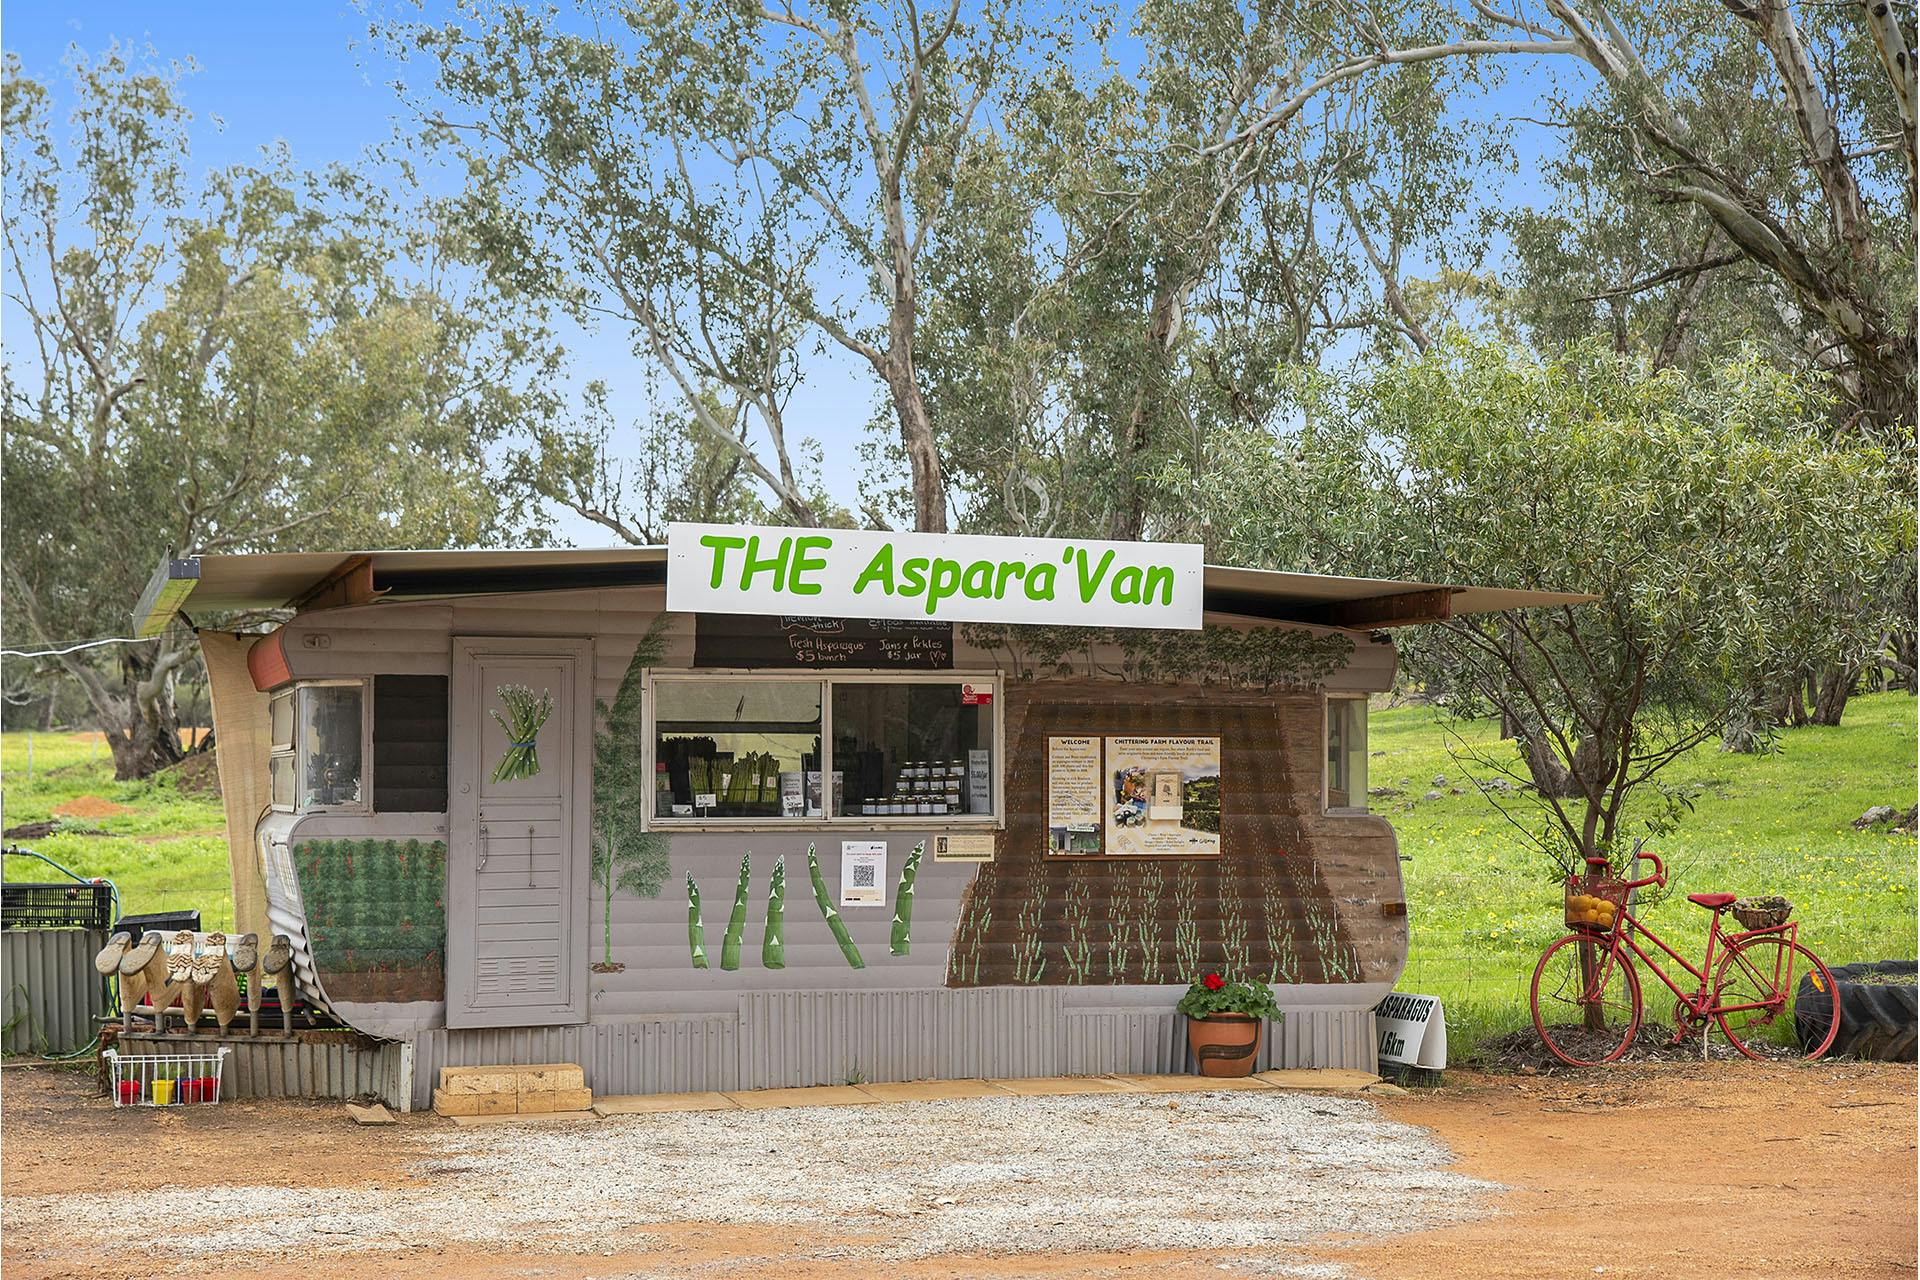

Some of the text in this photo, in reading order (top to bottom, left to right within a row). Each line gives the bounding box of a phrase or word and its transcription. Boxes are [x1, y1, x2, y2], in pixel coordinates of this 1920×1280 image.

[700, 535, 1174, 615] THE Aspara'Van
[811, 620, 840, 630] thick
[788, 633, 865, 653] Fresh Asparagus
[912, 635, 943, 649] Pickles
[795, 650, 847, 662] $5 bunch
[887, 651, 901, 661] $5
[1375, 995, 1434, 1023] ASPARAGUS
